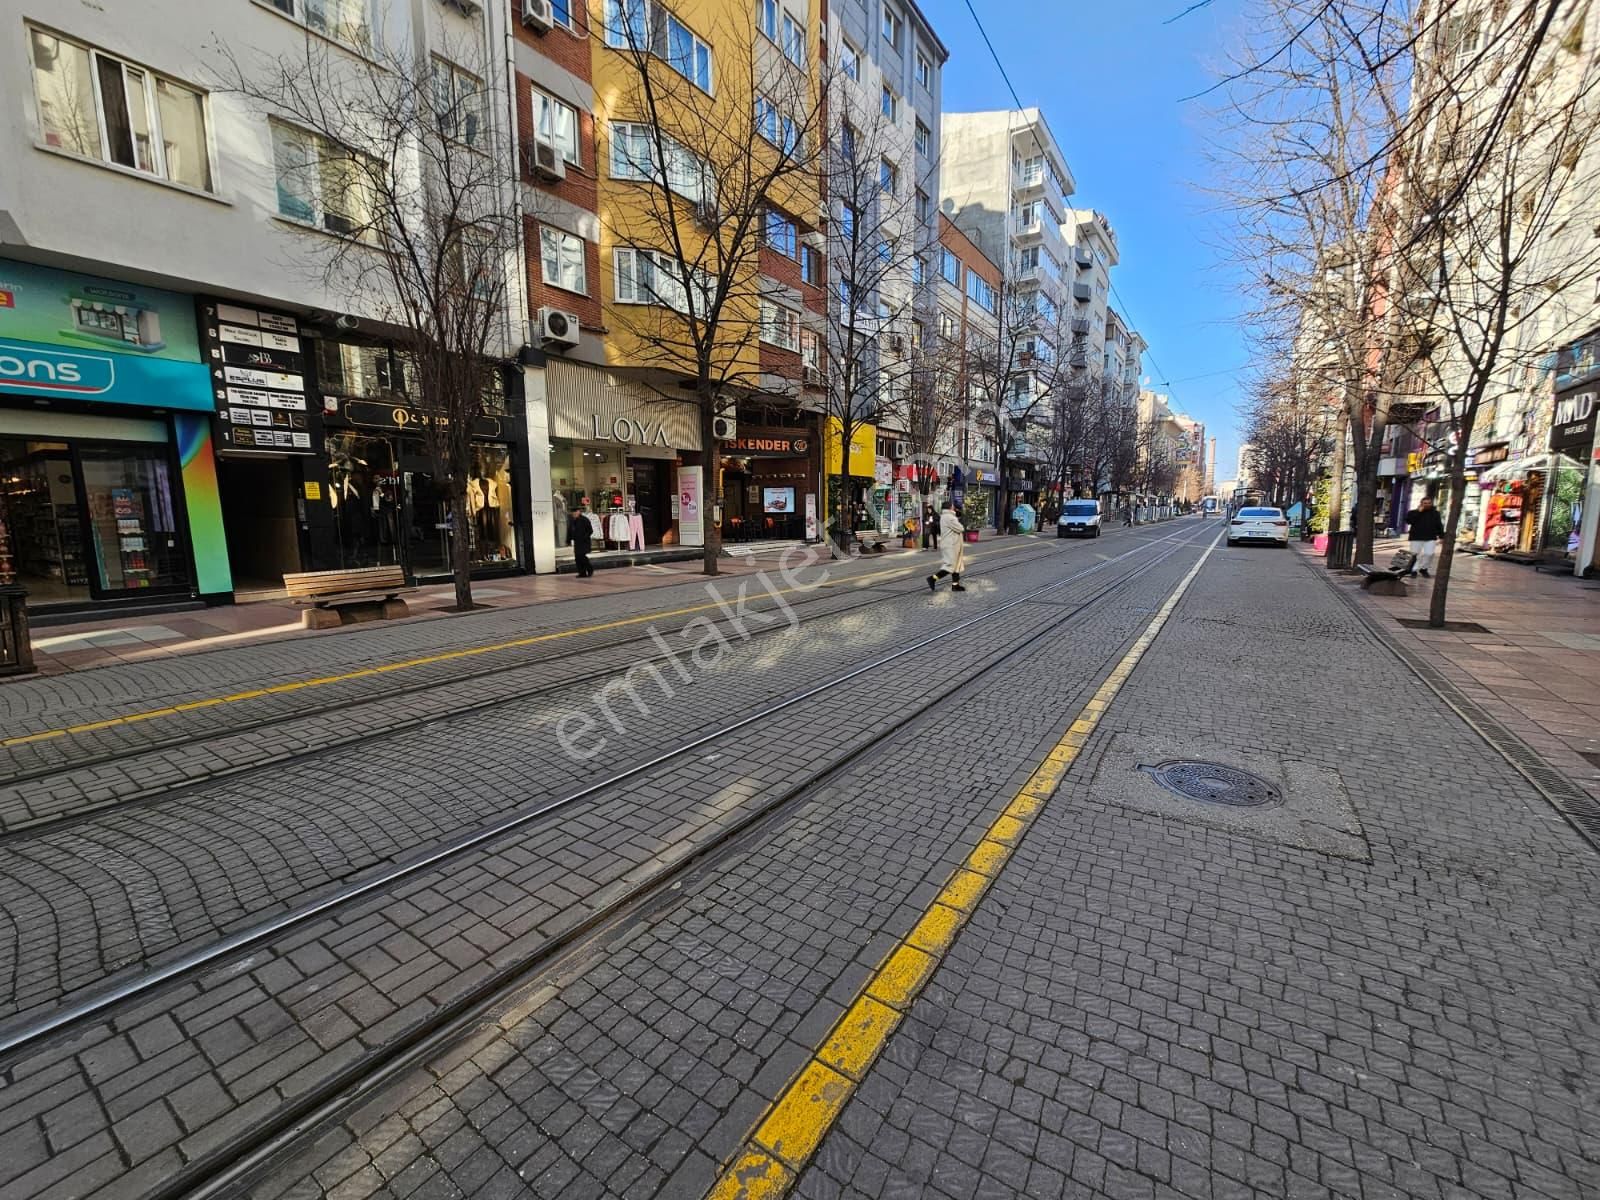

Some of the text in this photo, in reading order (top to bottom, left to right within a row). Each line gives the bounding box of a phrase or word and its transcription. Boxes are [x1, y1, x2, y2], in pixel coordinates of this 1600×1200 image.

[206, 307, 214, 316] 7
[214, 370, 223, 379] 4
[216, 390, 226, 399] 3
[220, 411, 229, 420] 2
[592, 414, 671, 447] LOYA
